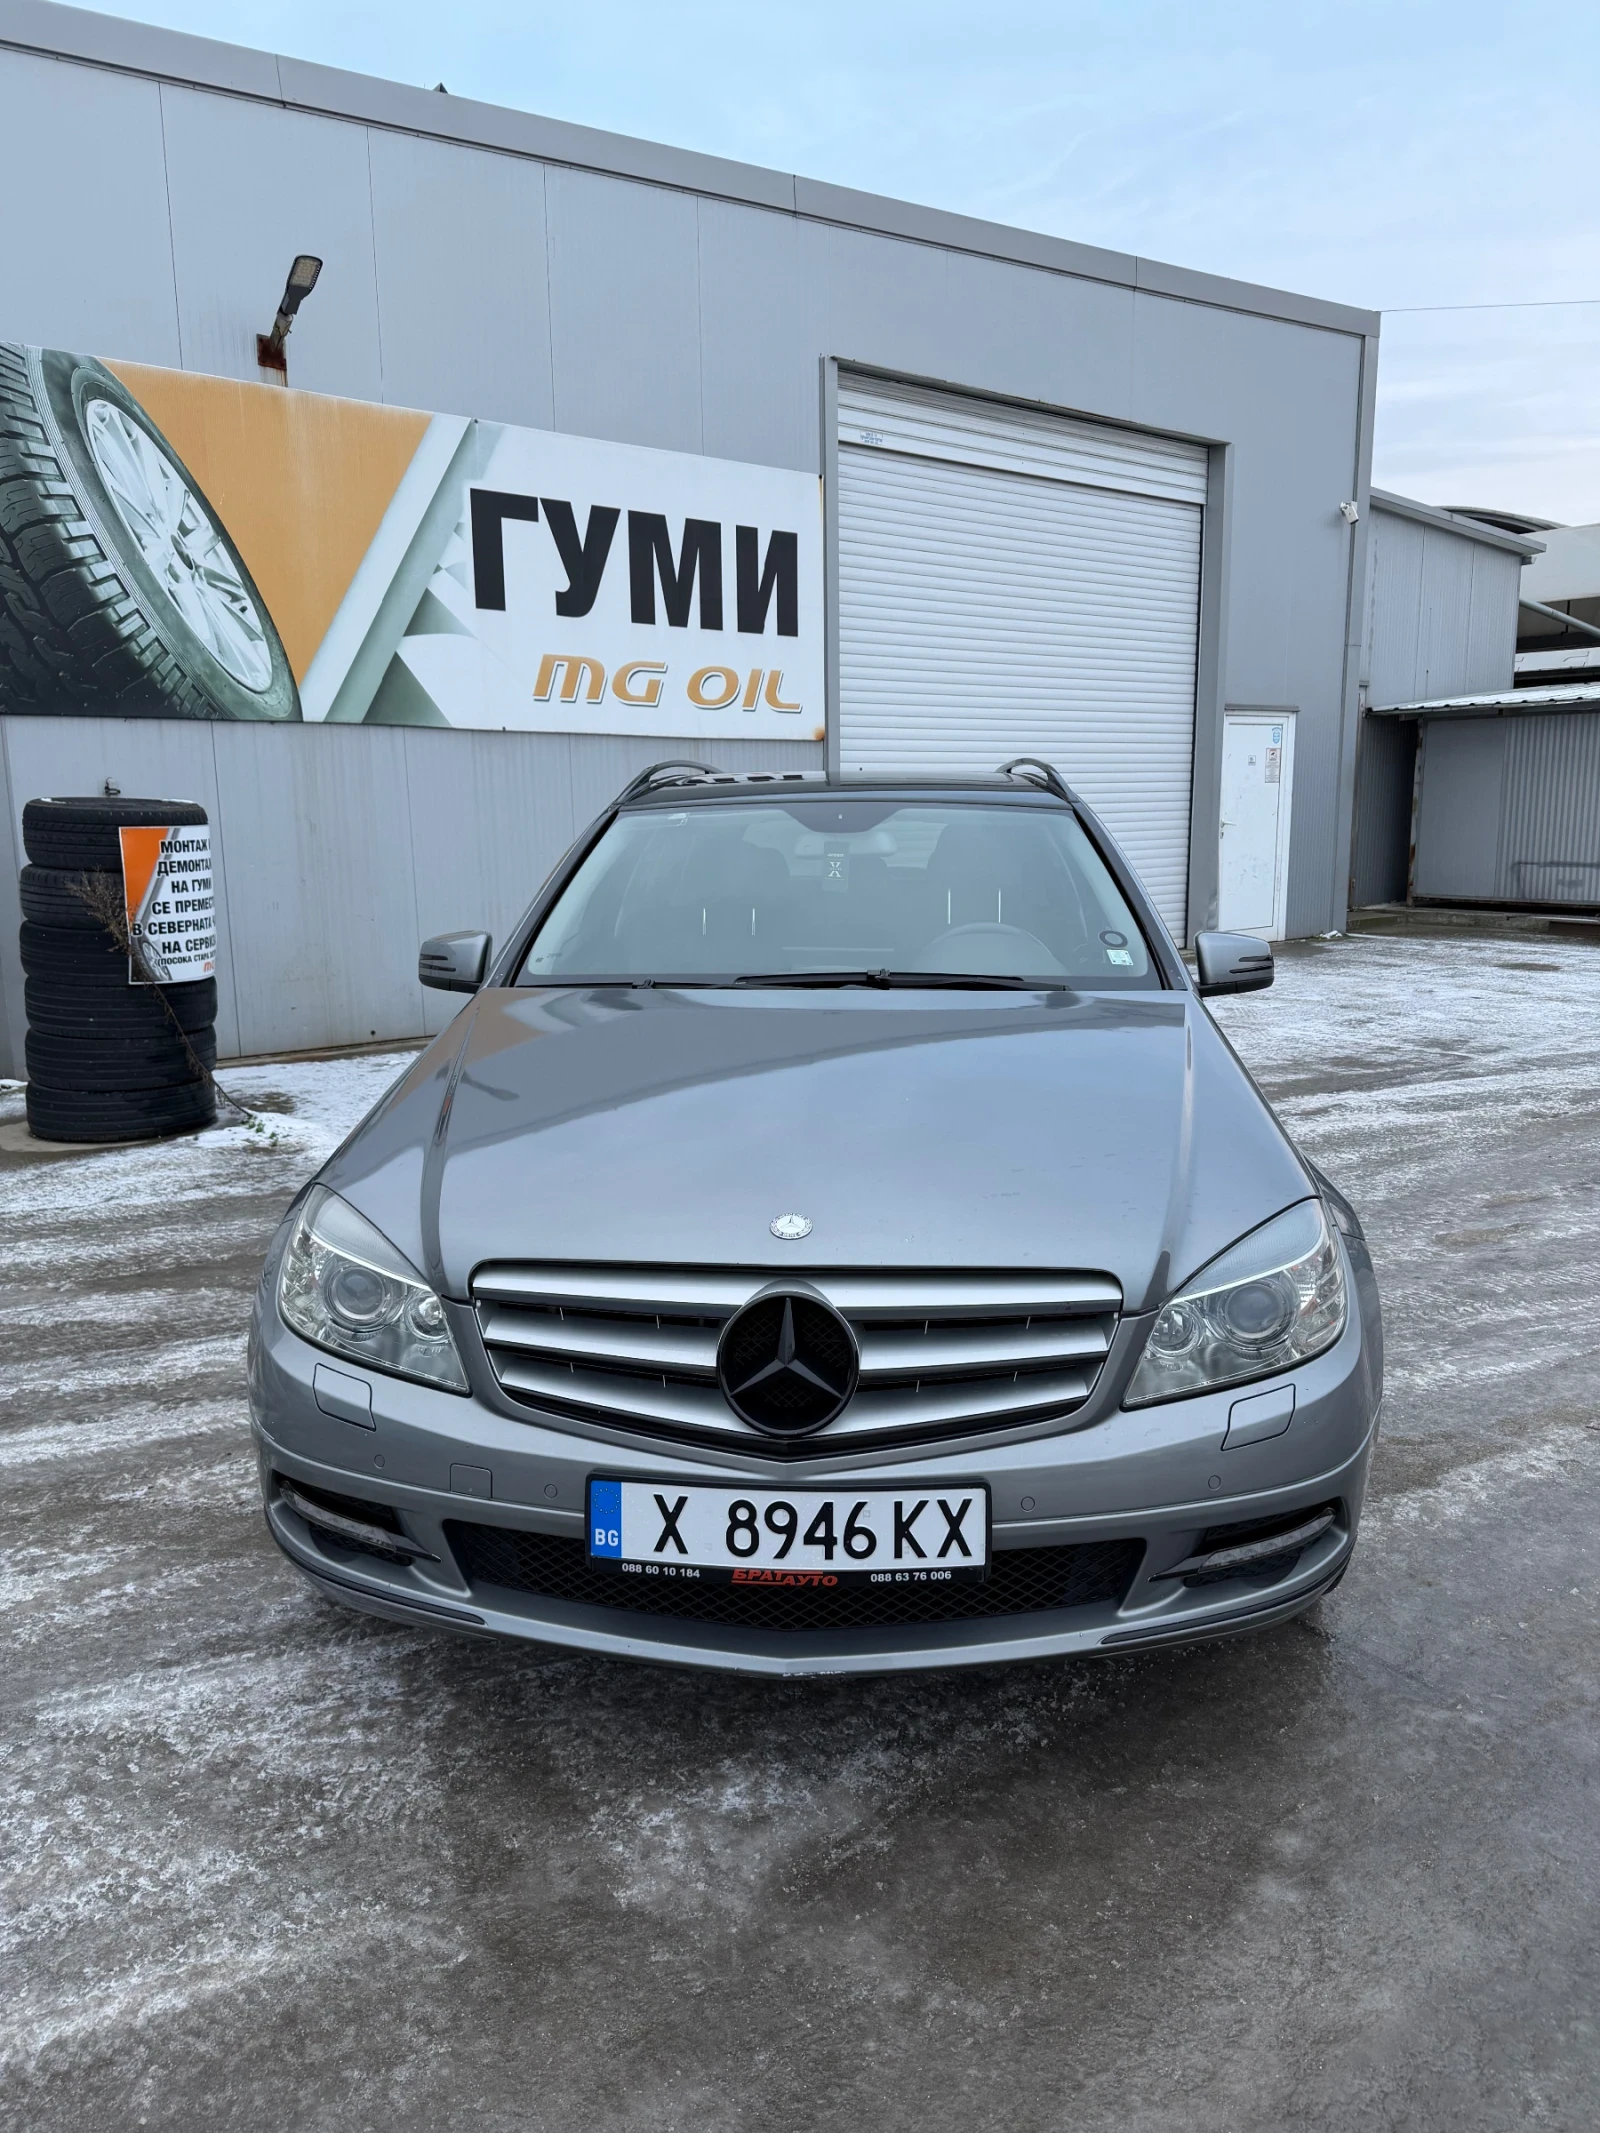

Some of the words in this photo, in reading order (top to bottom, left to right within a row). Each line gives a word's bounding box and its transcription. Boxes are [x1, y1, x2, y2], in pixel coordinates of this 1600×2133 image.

[470, 487, 799, 637] ГУМИ
[532, 654, 667, 707] MG
[686, 666, 802, 714] OIL
[160, 839, 208, 853] МОНТАЖ
[171, 880, 189, 893] НА
[152, 901, 171, 915] СЕ
[133, 923, 143, 937] В
[148, 917, 212, 936] СЕВЕРНАТА
[162, 941, 181, 954] НА
[653, 1494, 689, 1554] X
[725, 1499, 877, 1560] 8946
[894, 1498, 973, 1559] KX
[594, 1528, 619, 1546] BG
[622, 1563, 642, 1573] 088
[646, 1565, 659, 1575] 60
[663, 1566, 676, 1576] 10
[679, 1568, 700, 1578] 184
[870, 1573, 892, 1582] 088
[895, 1572, 909, 1581] 63
[913, 1572, 927, 1581] 76
[930, 1571, 952, 1580] 006
